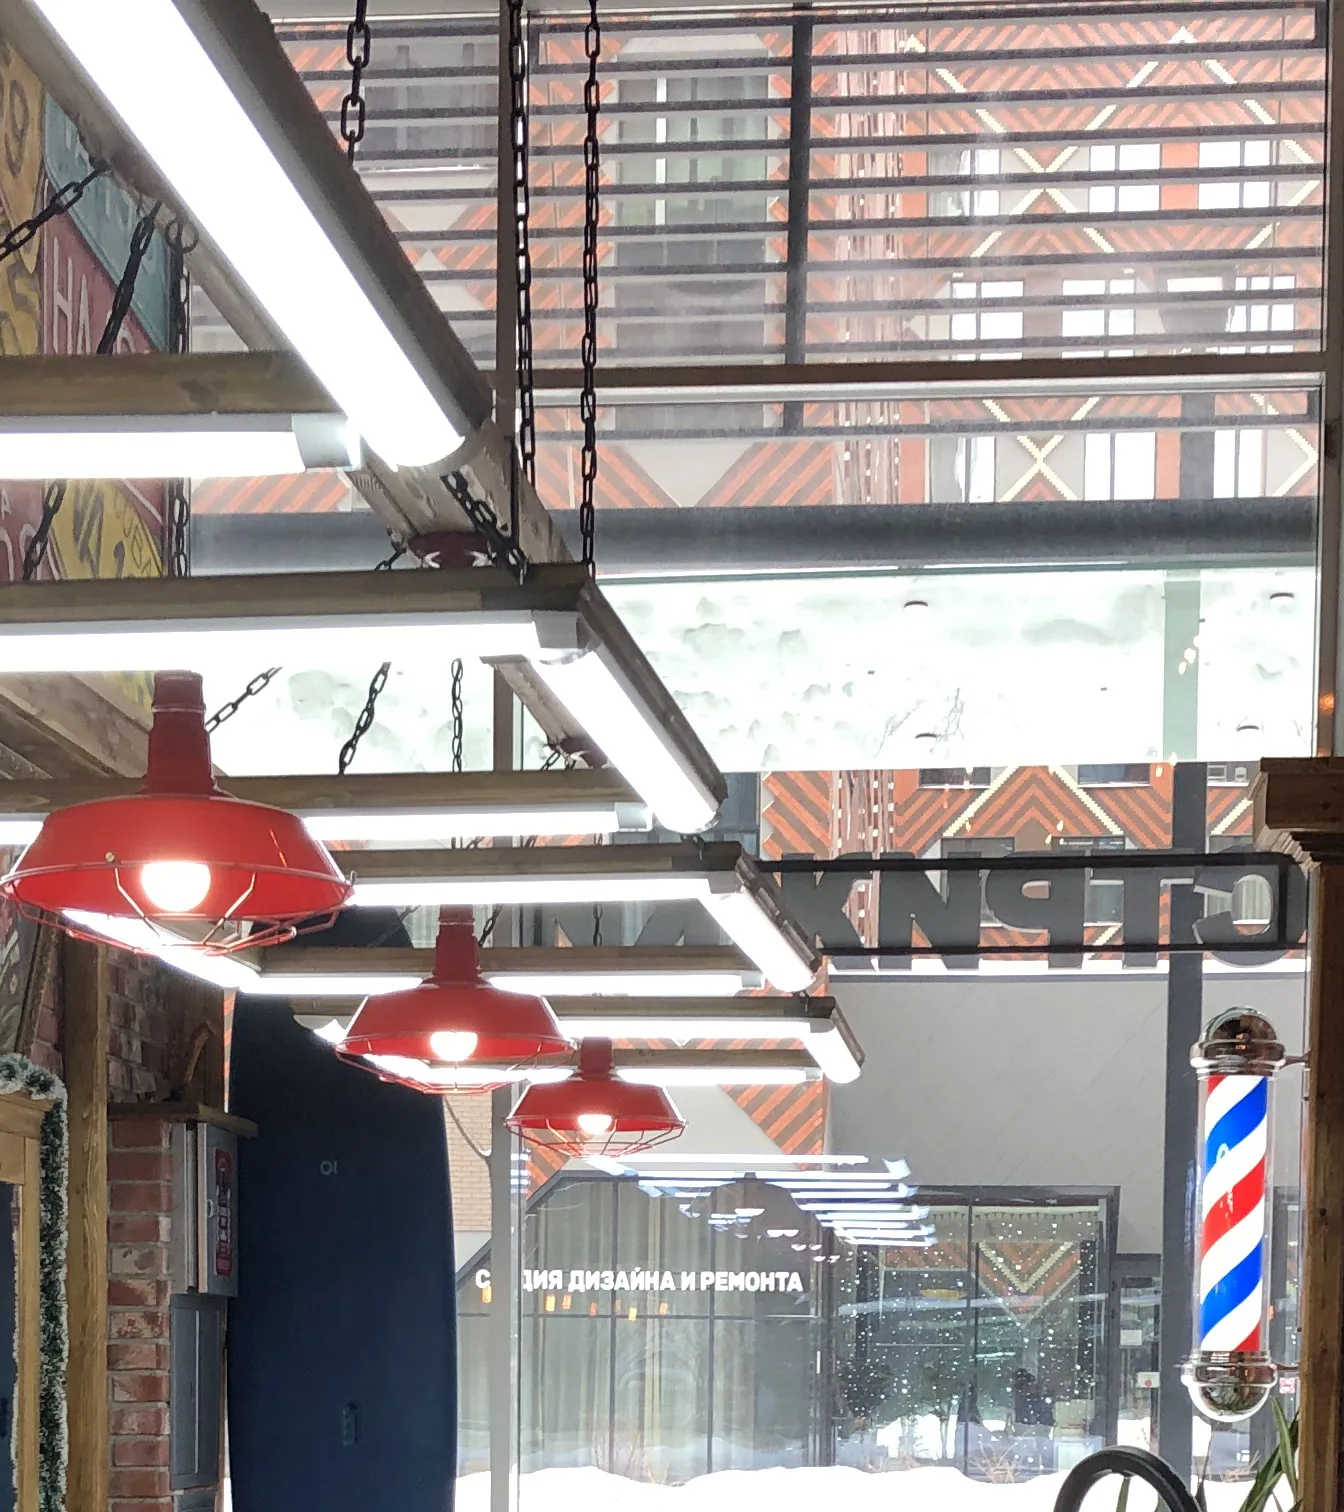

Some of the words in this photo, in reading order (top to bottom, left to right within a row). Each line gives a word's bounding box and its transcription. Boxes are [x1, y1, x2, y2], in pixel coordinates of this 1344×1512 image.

[475, 1269, 563, 1291] СДИЯ
[568, 1266, 676, 1293] ДИЗАЙНА
[681, 1271, 700, 1291] И
[701, 1271, 804, 1293] РЕМОНТА
